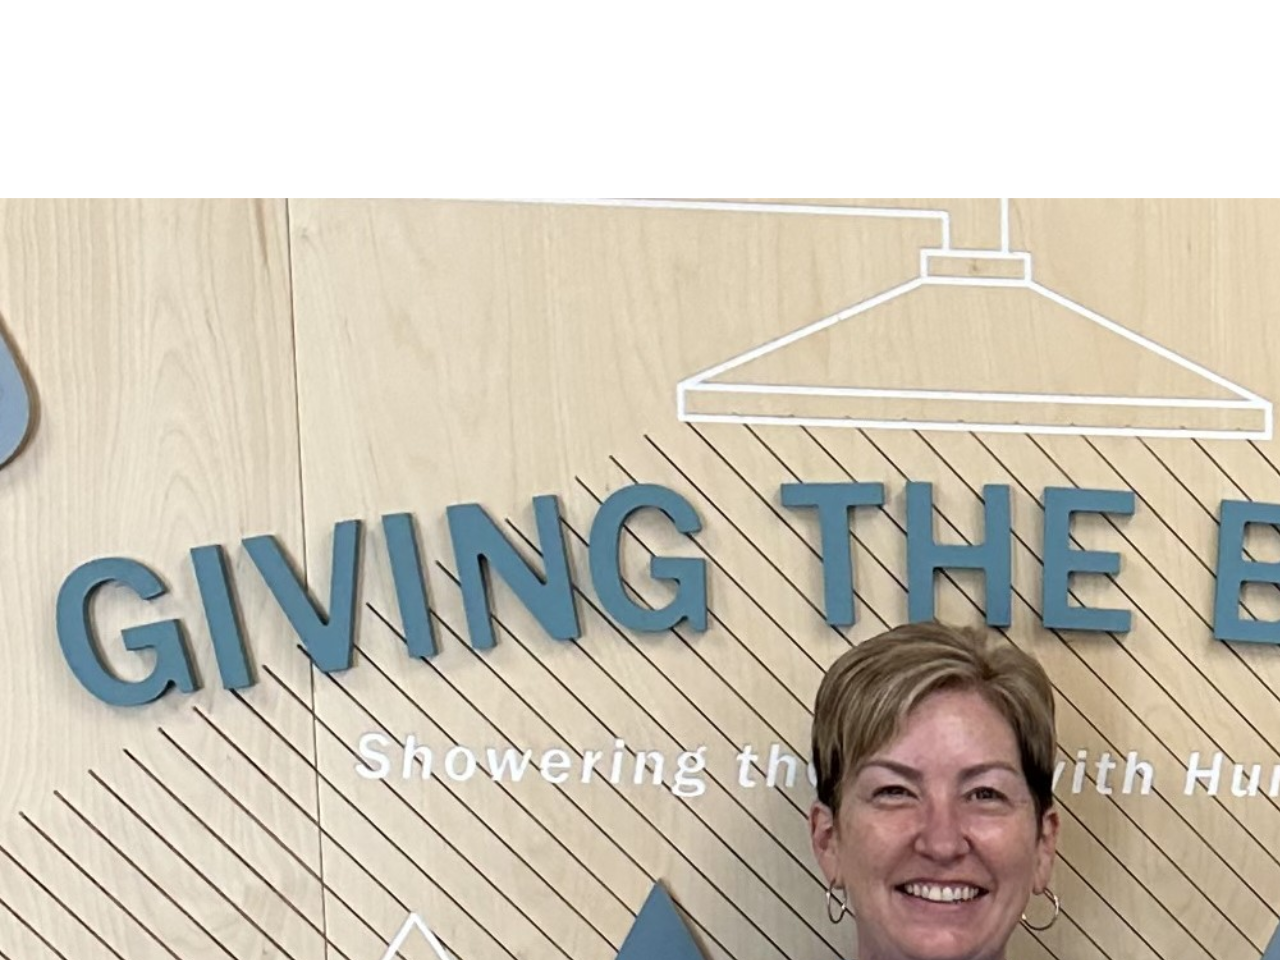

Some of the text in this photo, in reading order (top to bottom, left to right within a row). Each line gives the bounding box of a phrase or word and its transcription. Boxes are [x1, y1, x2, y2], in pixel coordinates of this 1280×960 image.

[56, 483, 709, 707] GIVING
[780, 481, 1136, 635] THE
[355, 732, 708, 798] Showering
